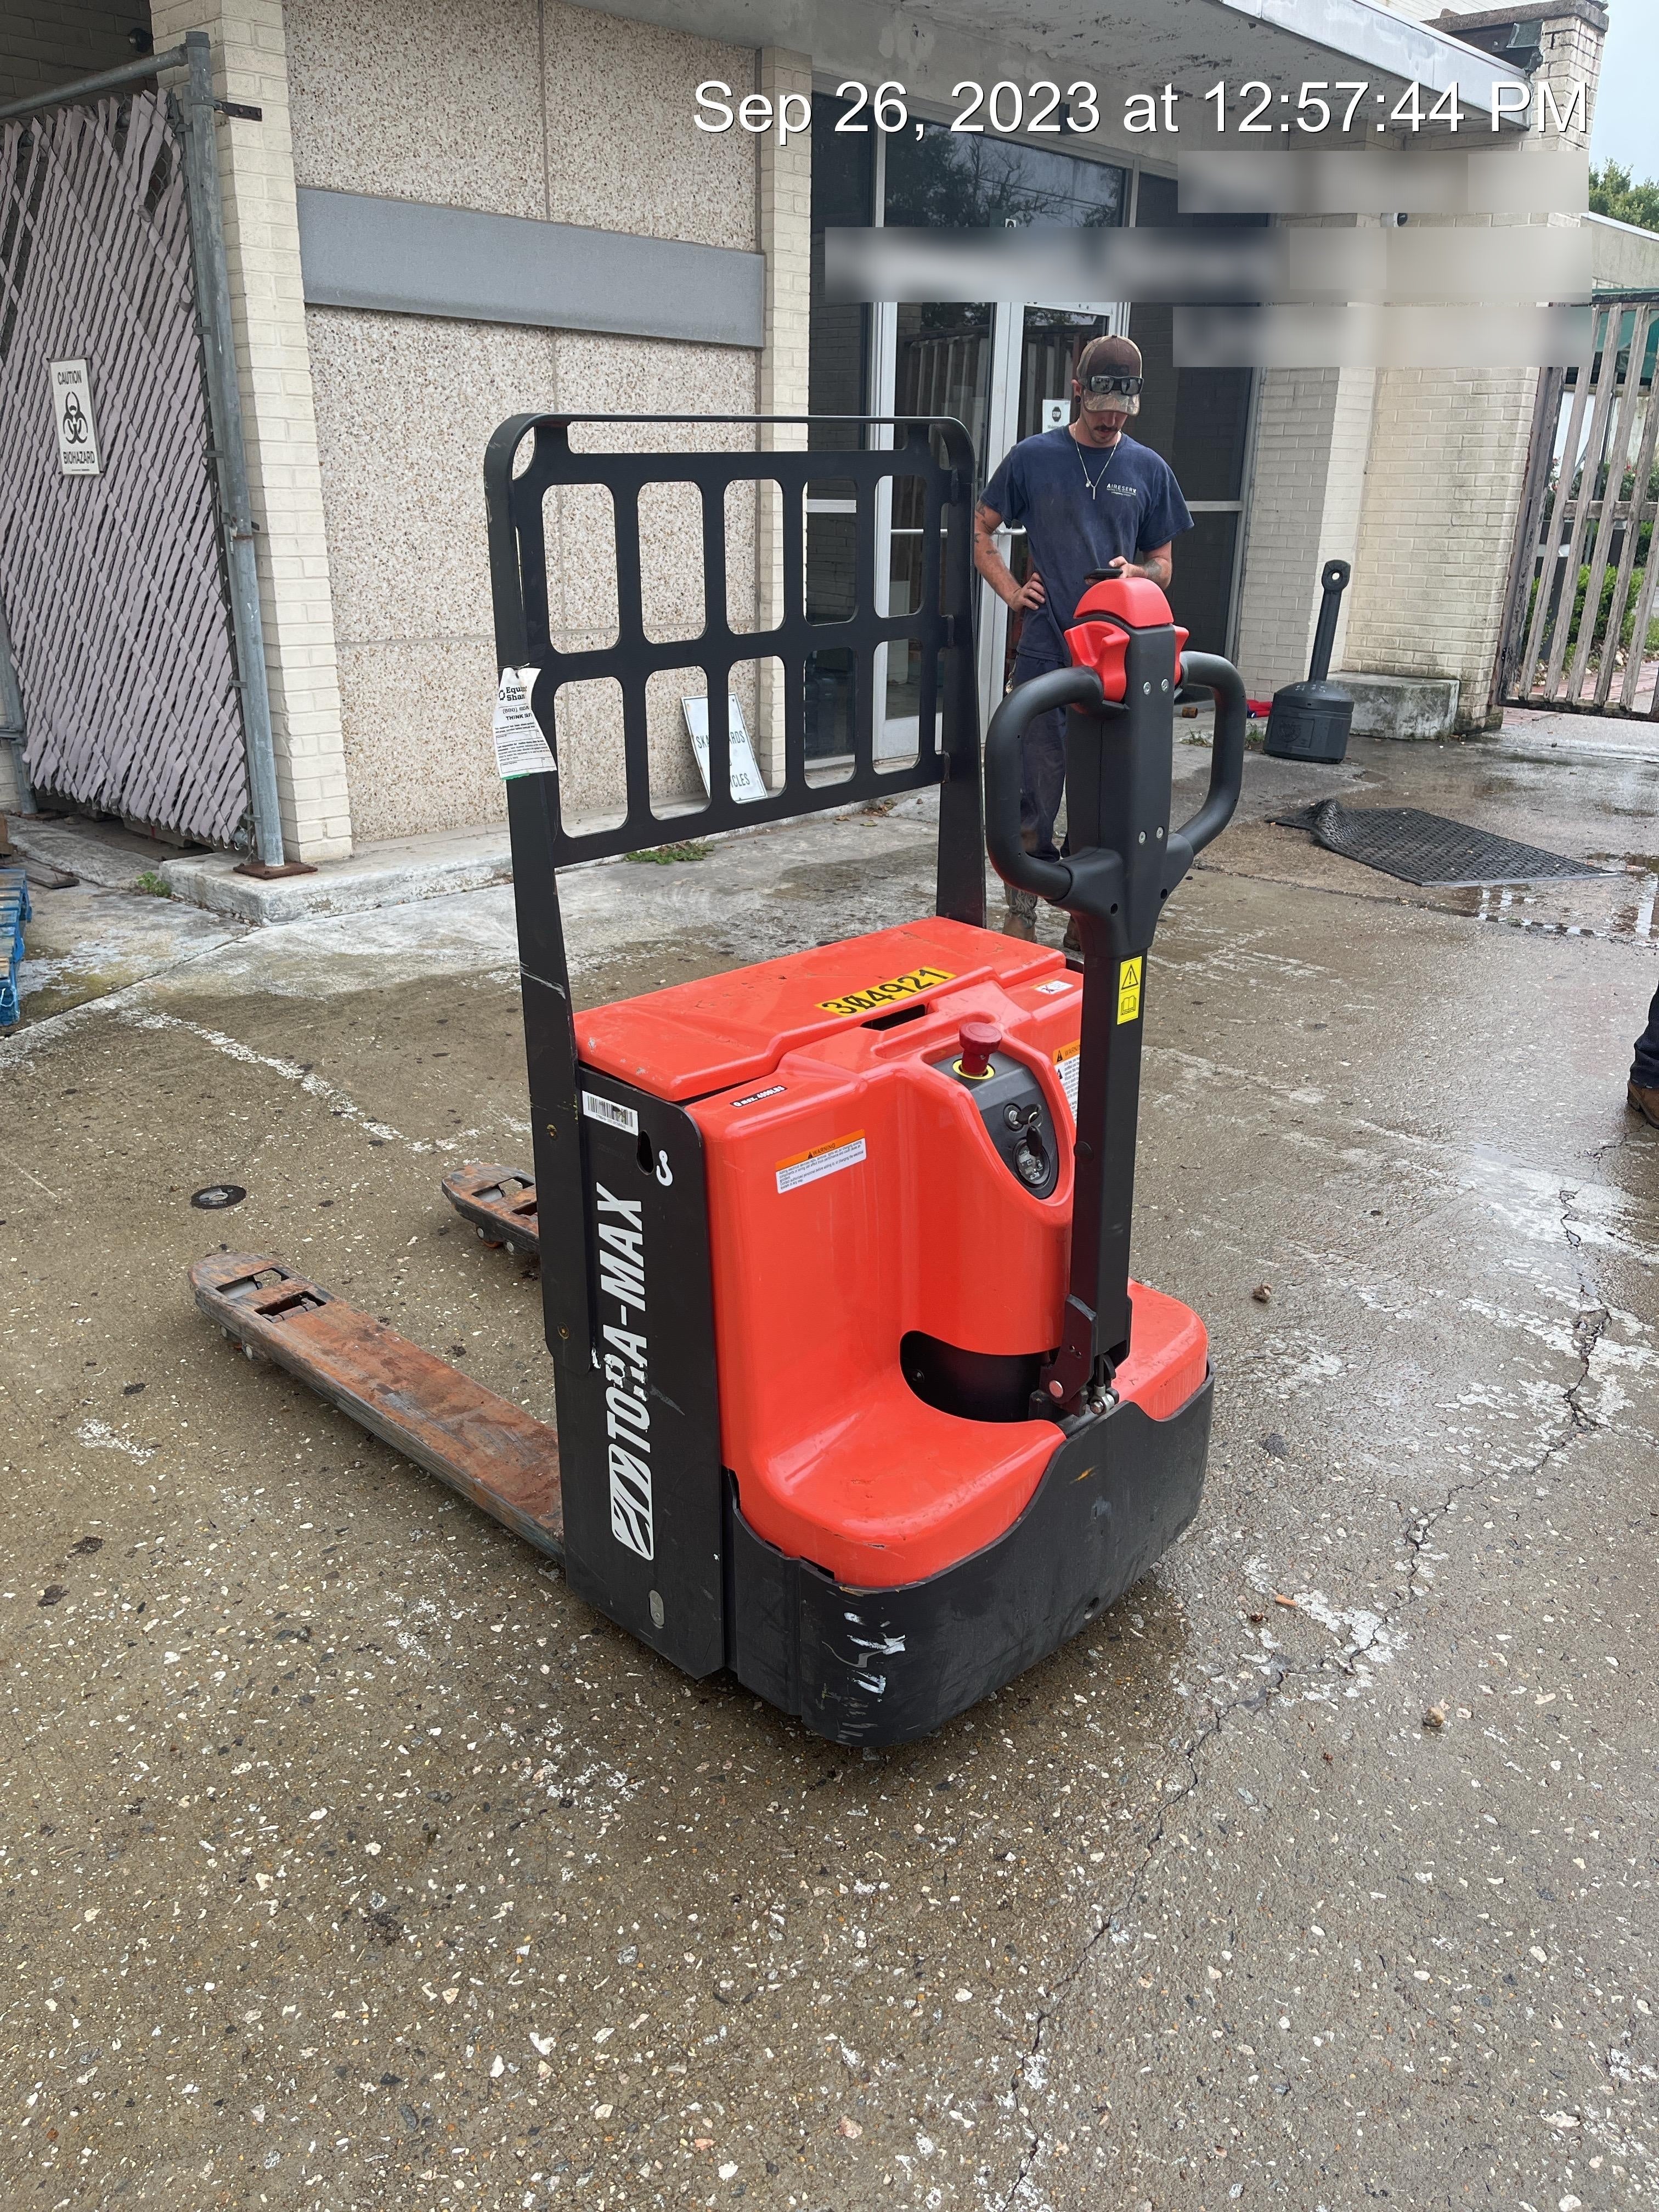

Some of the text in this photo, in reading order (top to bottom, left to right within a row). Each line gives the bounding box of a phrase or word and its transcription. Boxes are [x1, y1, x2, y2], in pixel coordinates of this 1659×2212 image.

[57, 370, 82, 385] CAUTION
[63, 451, 95, 464] BIOHAZARD
[1107, 483, 1137, 493] AIRESERV
[821, 969, 949, 1014] 304921
[812, 1142, 835, 1156] WARNING
